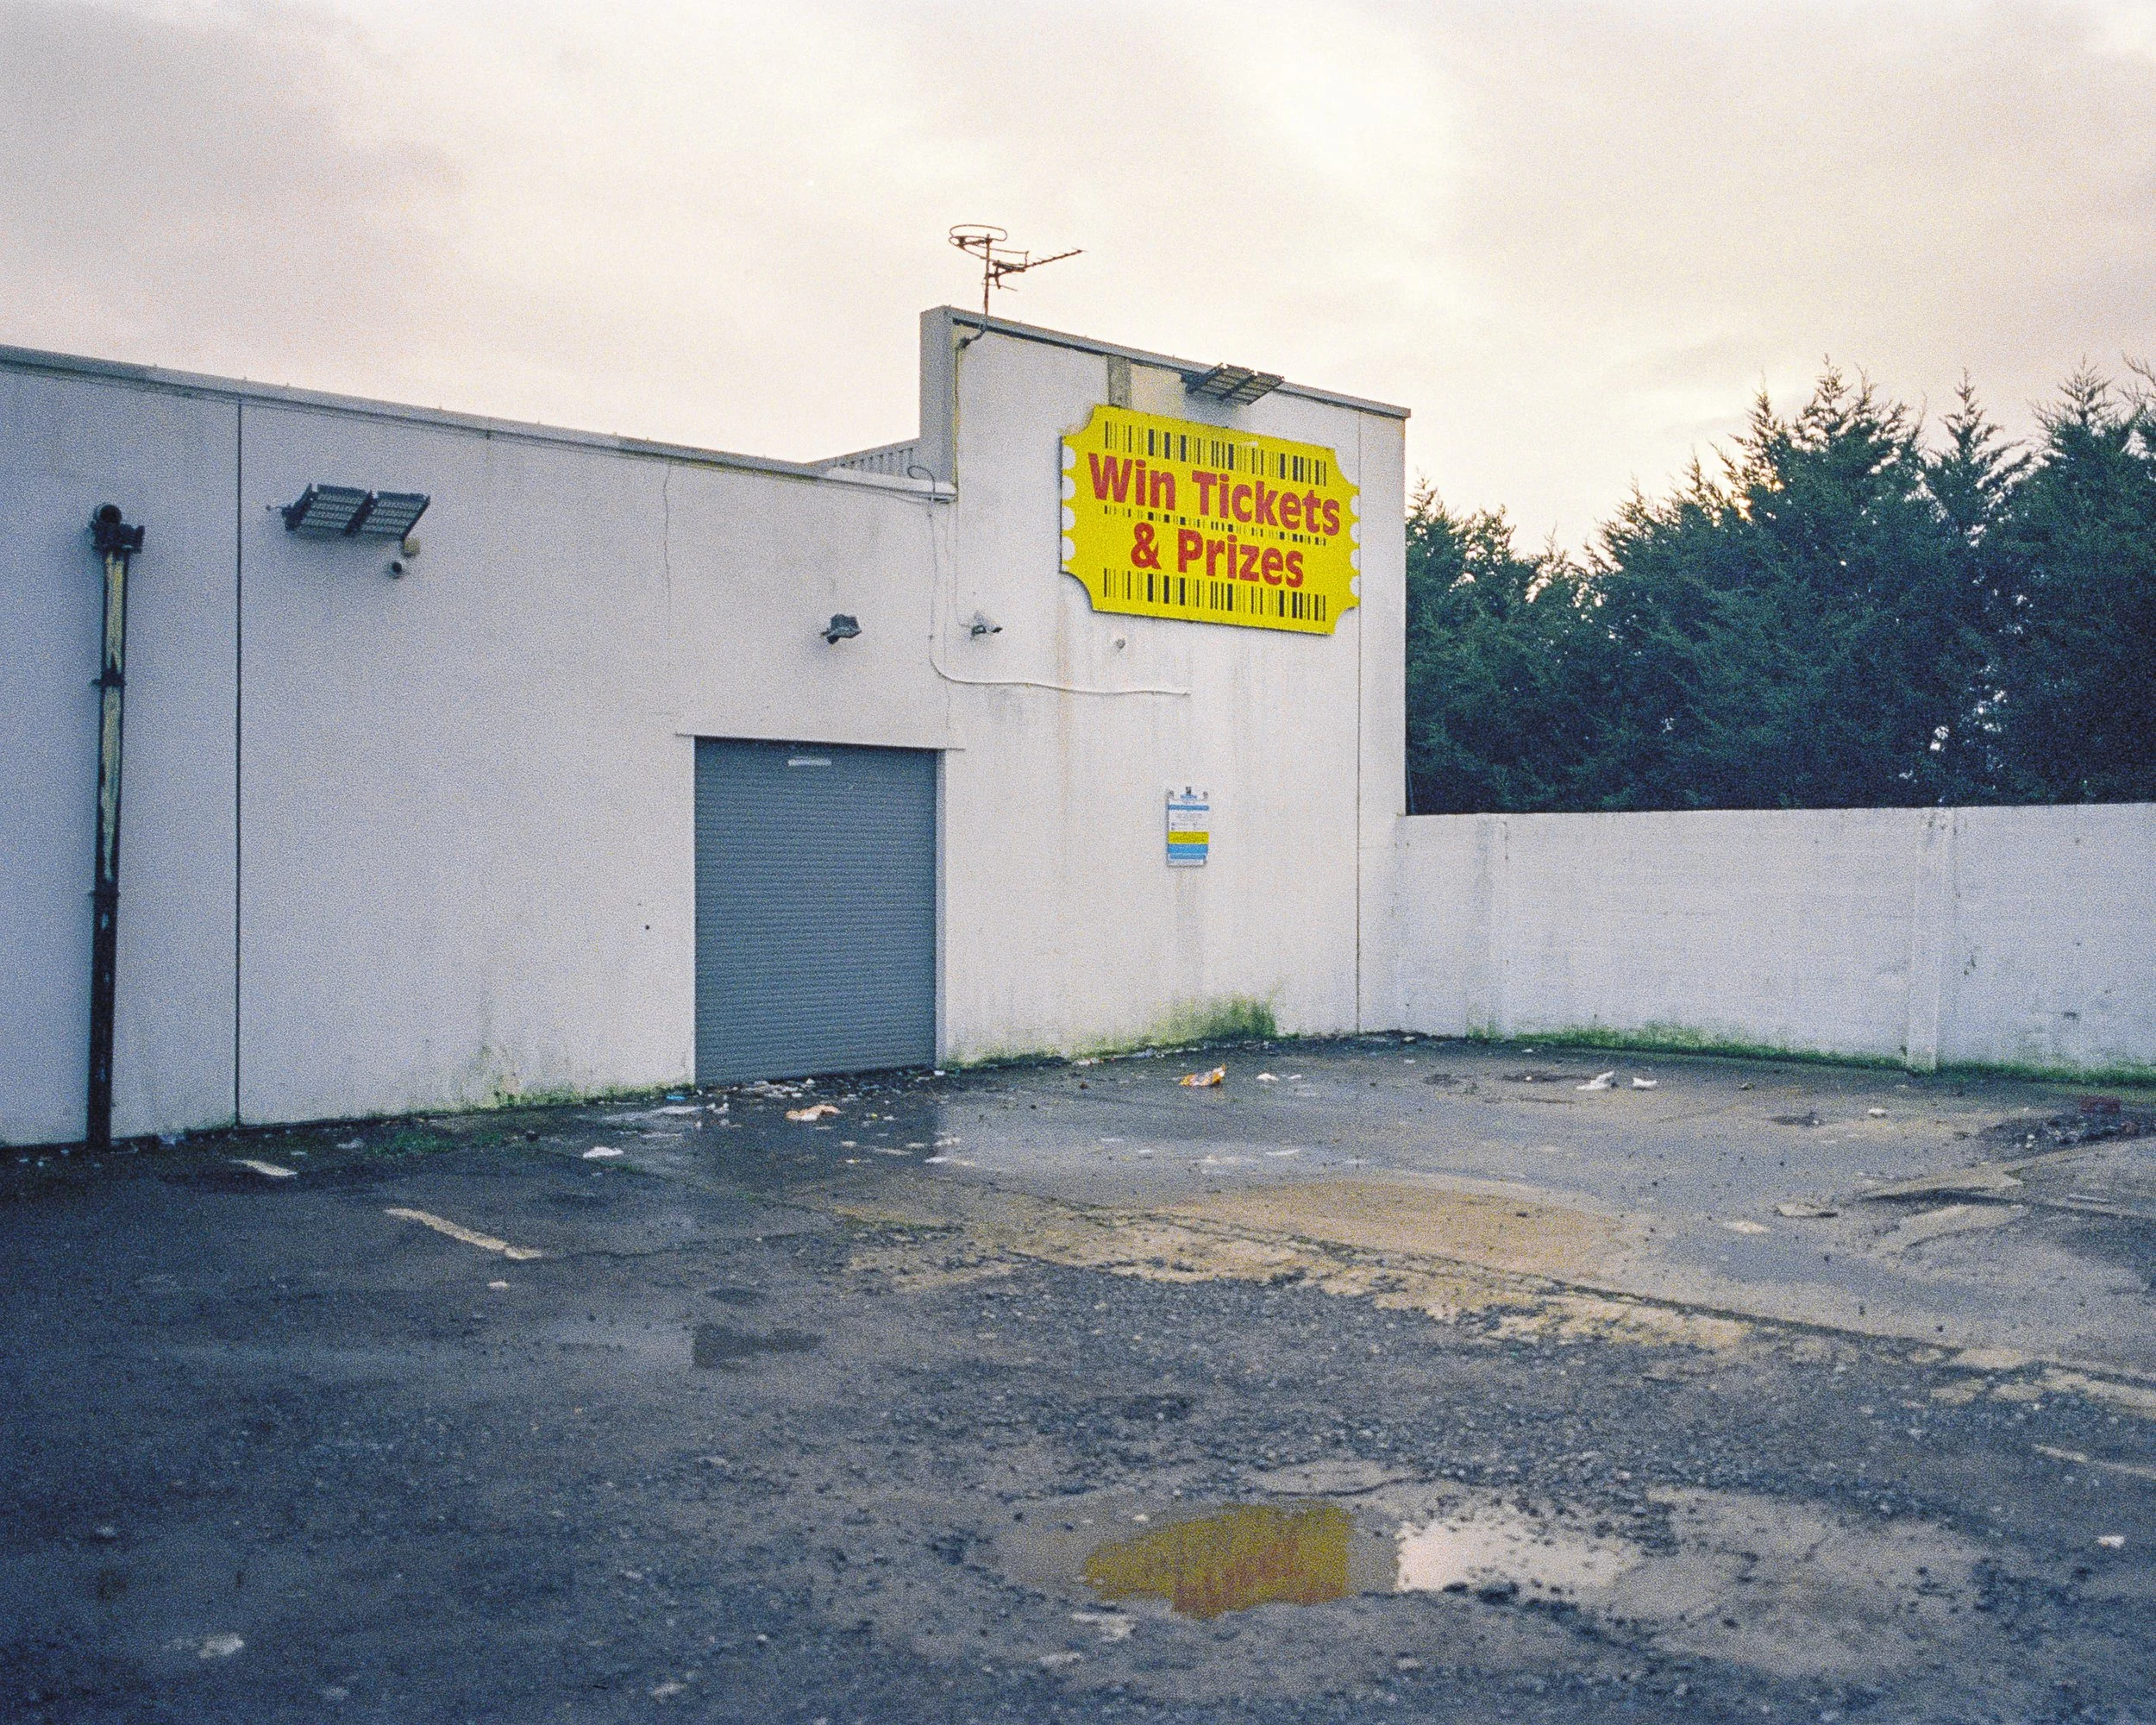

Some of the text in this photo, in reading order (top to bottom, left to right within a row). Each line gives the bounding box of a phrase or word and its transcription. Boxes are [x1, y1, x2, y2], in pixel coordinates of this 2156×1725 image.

[1088, 453, 1340, 536] Win Tickets
[1130, 522, 1304, 589] & Prizes
